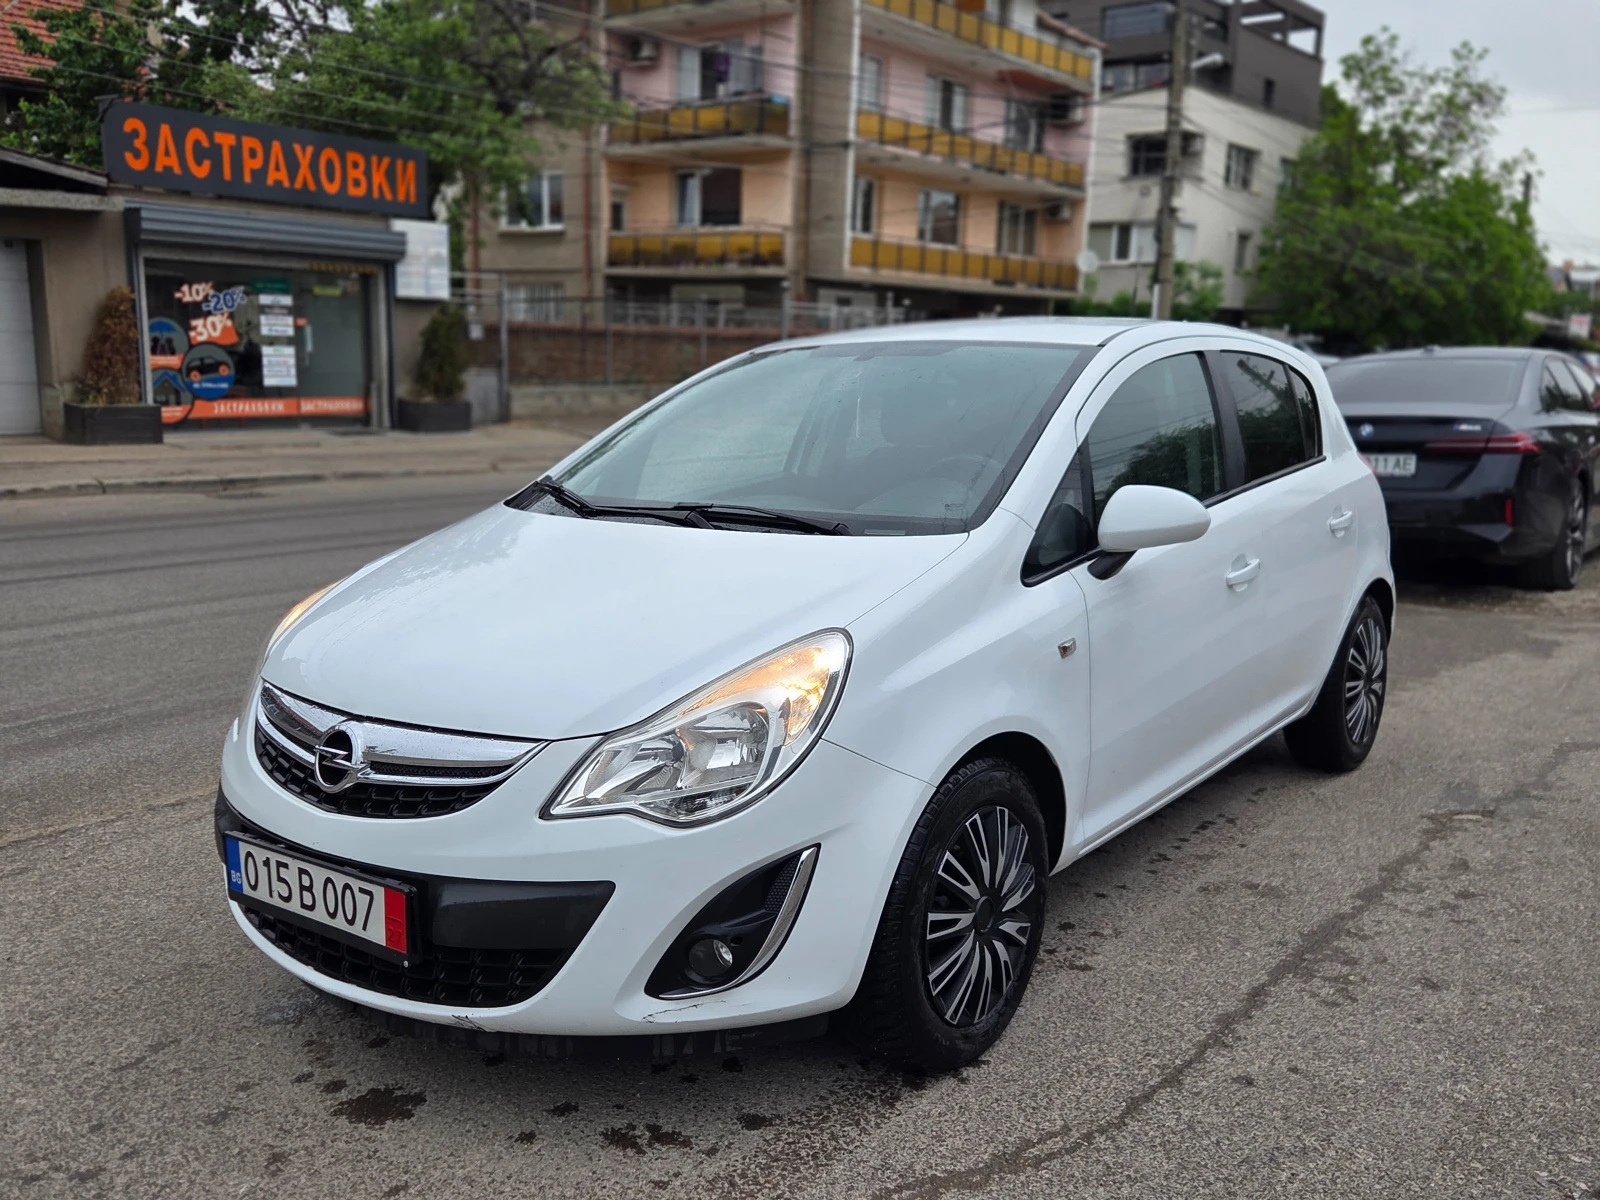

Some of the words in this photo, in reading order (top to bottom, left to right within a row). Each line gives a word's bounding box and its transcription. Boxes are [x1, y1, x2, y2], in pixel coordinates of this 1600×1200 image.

[122, 117, 418, 204] ЗАСТРАХОВКИ
[174, 282, 213, 303] -10%
[202, 286, 246, 313] -20%
[188, 311, 233, 342] -30%
[231, 870, 242, 884] BG
